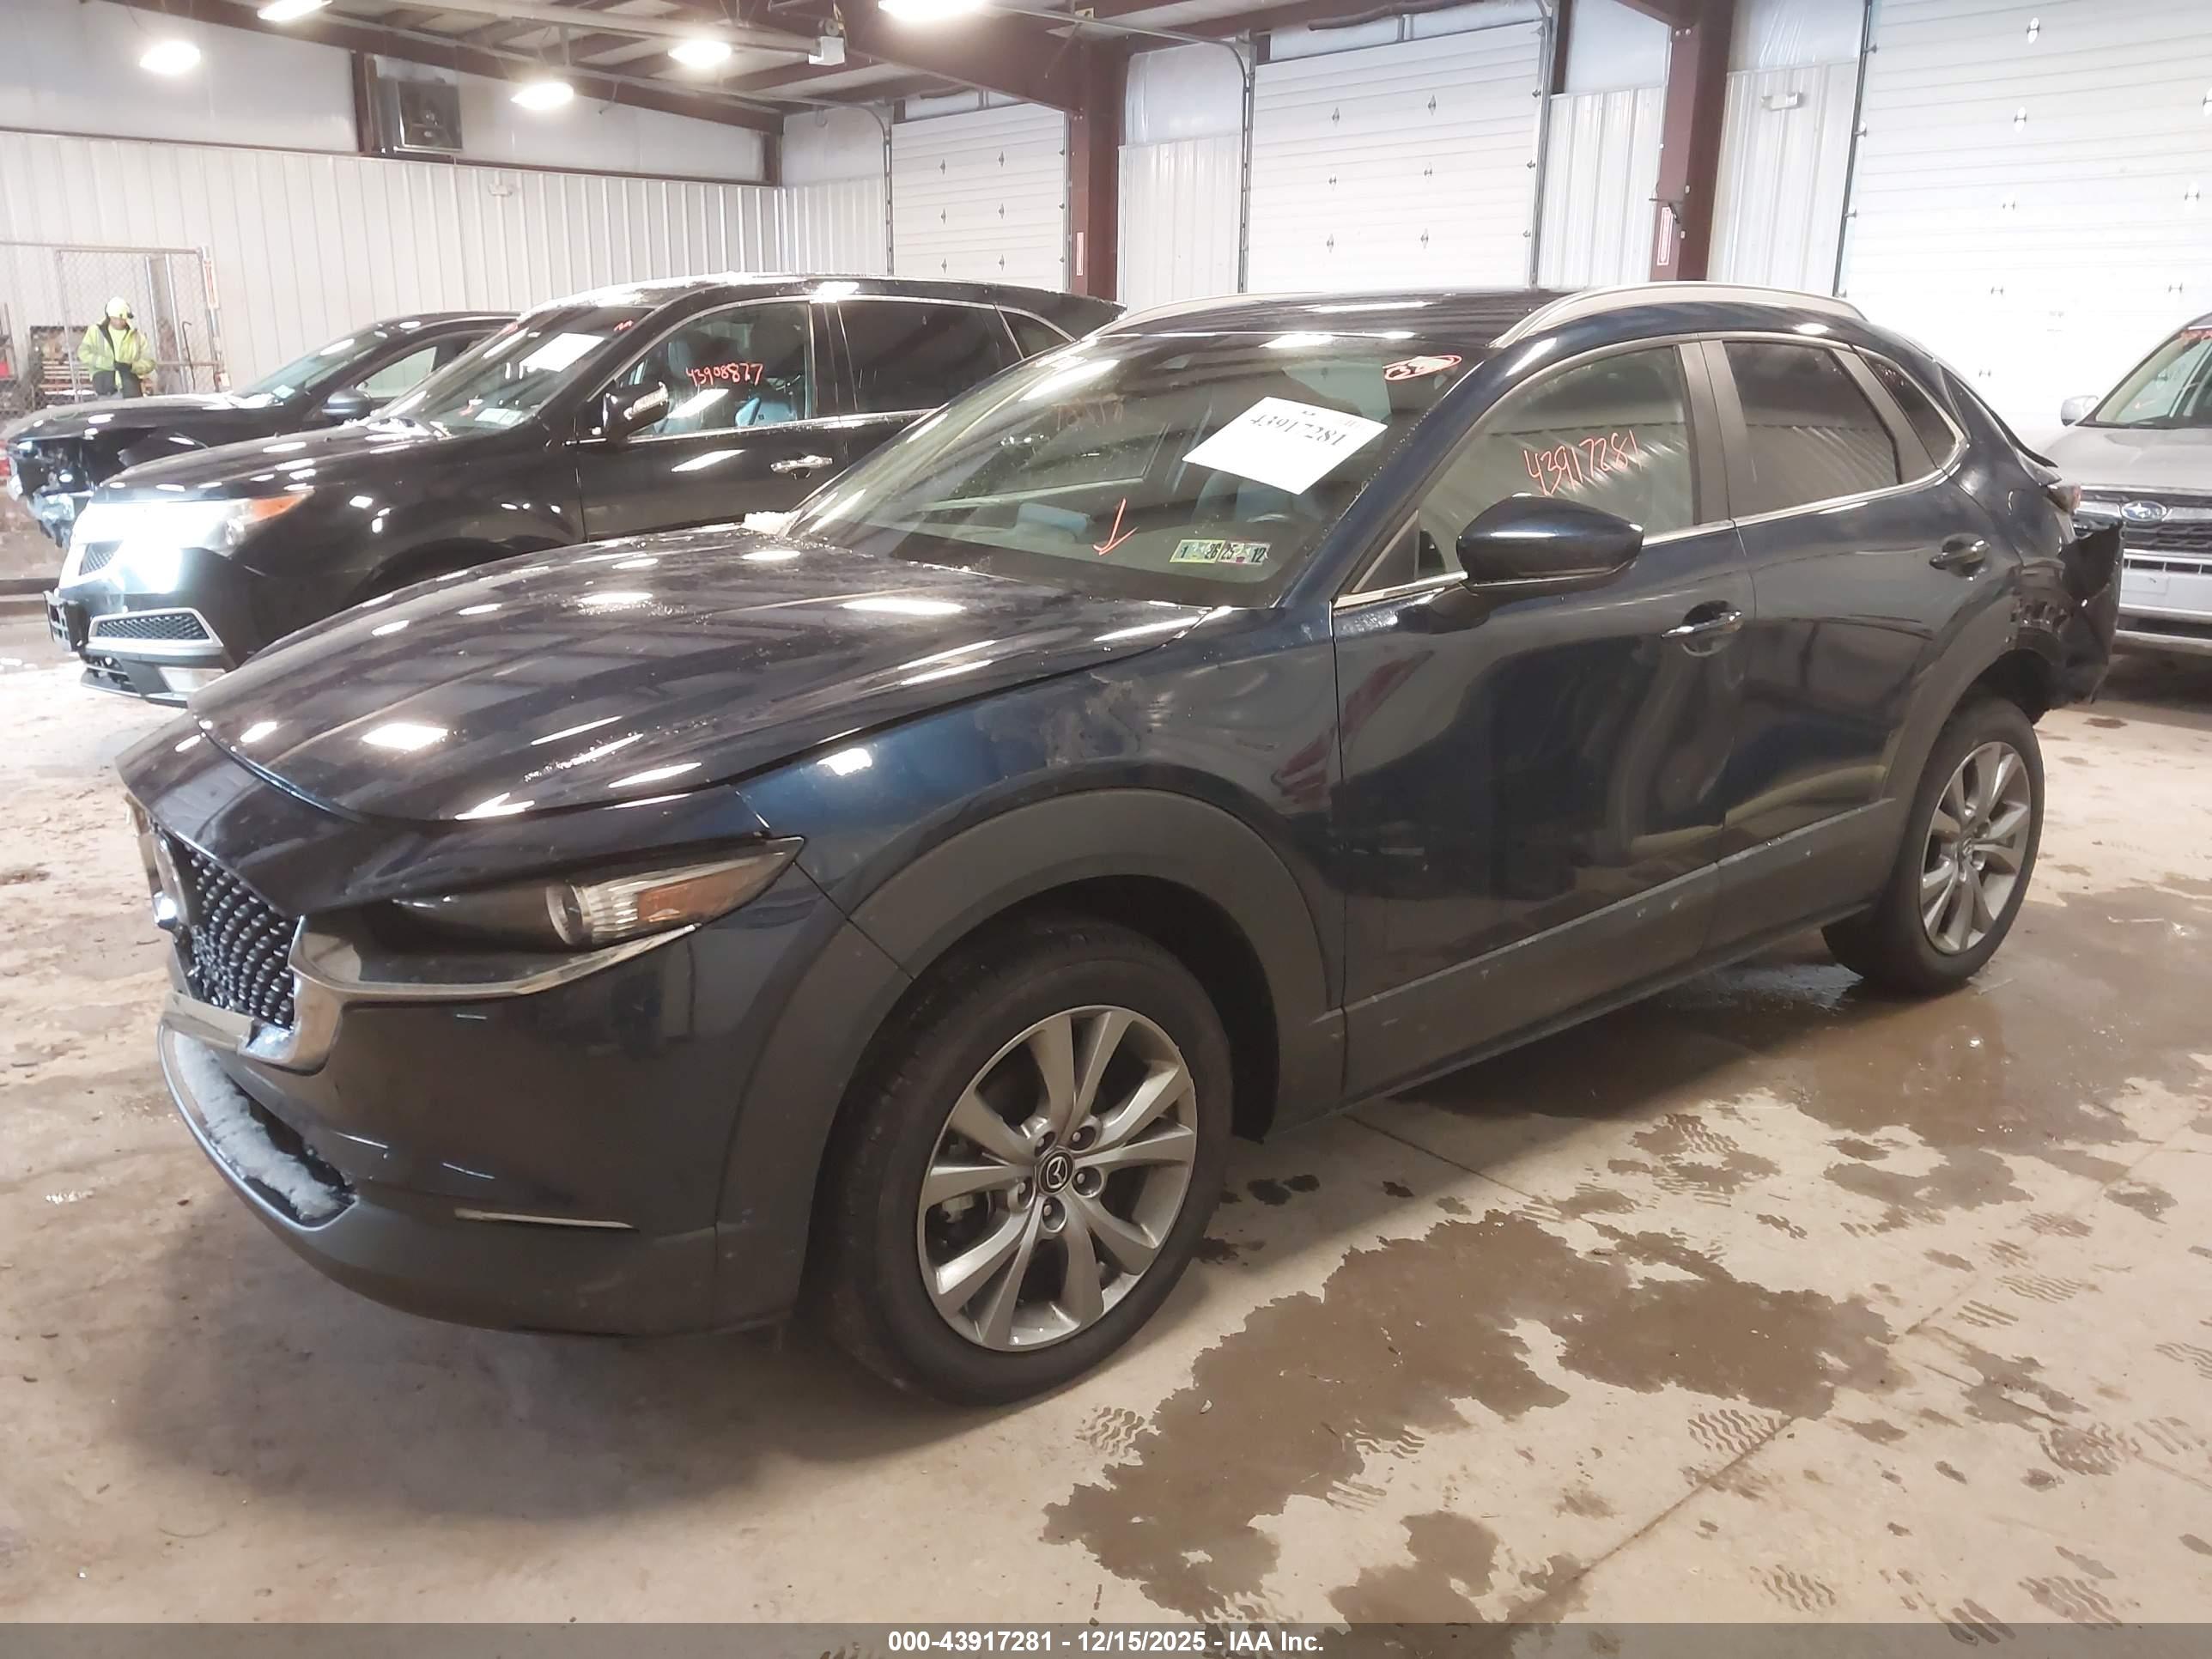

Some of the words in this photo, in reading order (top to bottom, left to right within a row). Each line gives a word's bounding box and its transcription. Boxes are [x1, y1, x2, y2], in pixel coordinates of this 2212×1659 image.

[685, 362, 763, 387] 43908877
[1250, 414, 1346, 445] 43917281
[1523, 429, 1643, 496] 43917281
[1181, 545, 1189, 559] 1
[1204, 543, 1221, 560] 26
[1220, 544, 1238, 560] 25
[1250, 547, 1267, 563] 12
